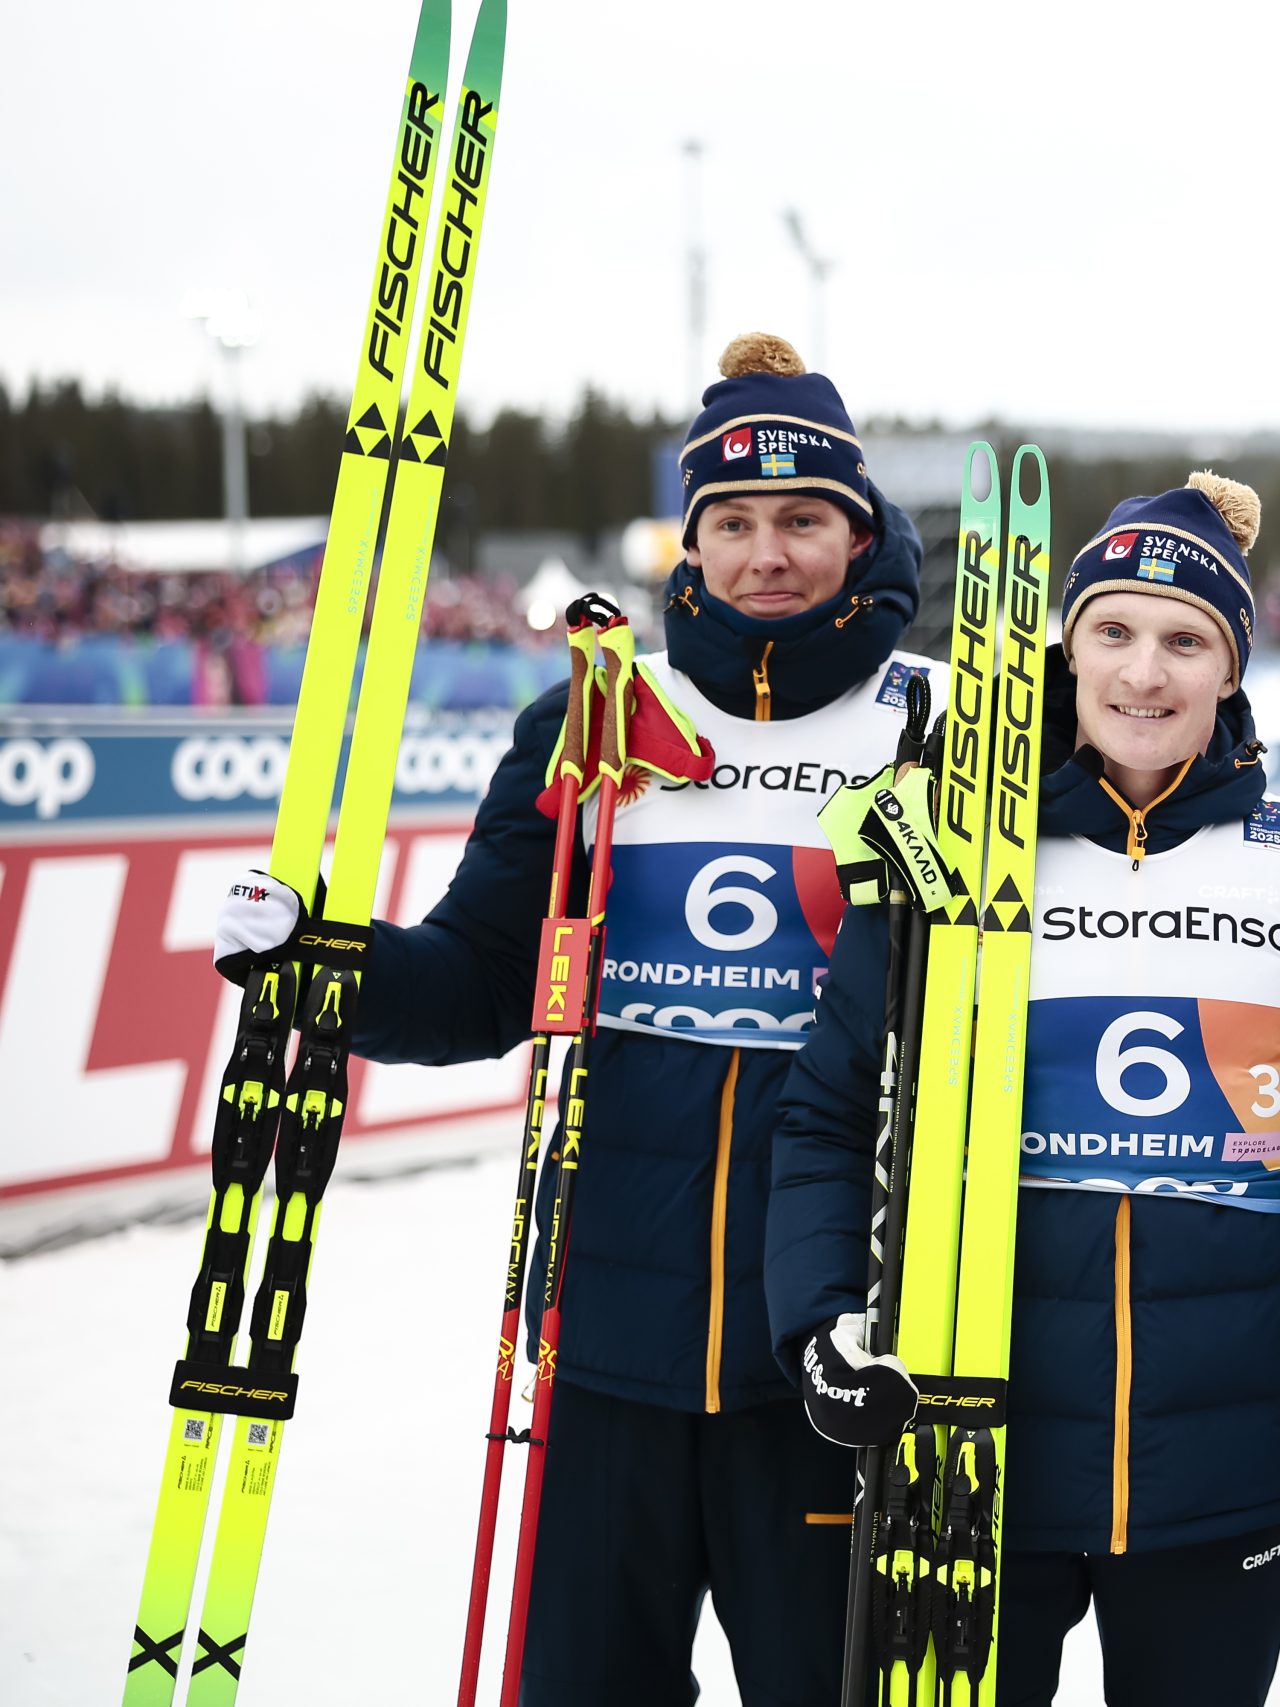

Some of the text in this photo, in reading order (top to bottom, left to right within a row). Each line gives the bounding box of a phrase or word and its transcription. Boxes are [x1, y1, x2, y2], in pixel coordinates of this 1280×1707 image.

[368, 80, 440, 383] FISCHER
[423, 89, 493, 391] FISCHER
[756, 429, 832, 450] SVENSKA
[758, 441, 798, 454] SPEL
[1140, 546, 1182, 564] SPEL
[1143, 535, 1219, 576] SVENSKA
[881, 693, 908, 708] 202
[945, 529, 993, 843] FISCHER
[999, 534, 1043, 850] FISCHER
[170, 736, 293, 803] coo
[395, 737, 514, 800] coo
[1249, 830, 1280, 844] 2025
[685, 854, 778, 951] 6
[546, 926, 574, 1022] LEKI
[1095, 1010, 1192, 1118] 6
[526, 1068, 548, 1170] LEKI
[561, 1067, 588, 1170] LEKI
[180, 1380, 289, 1402] FISCHER
